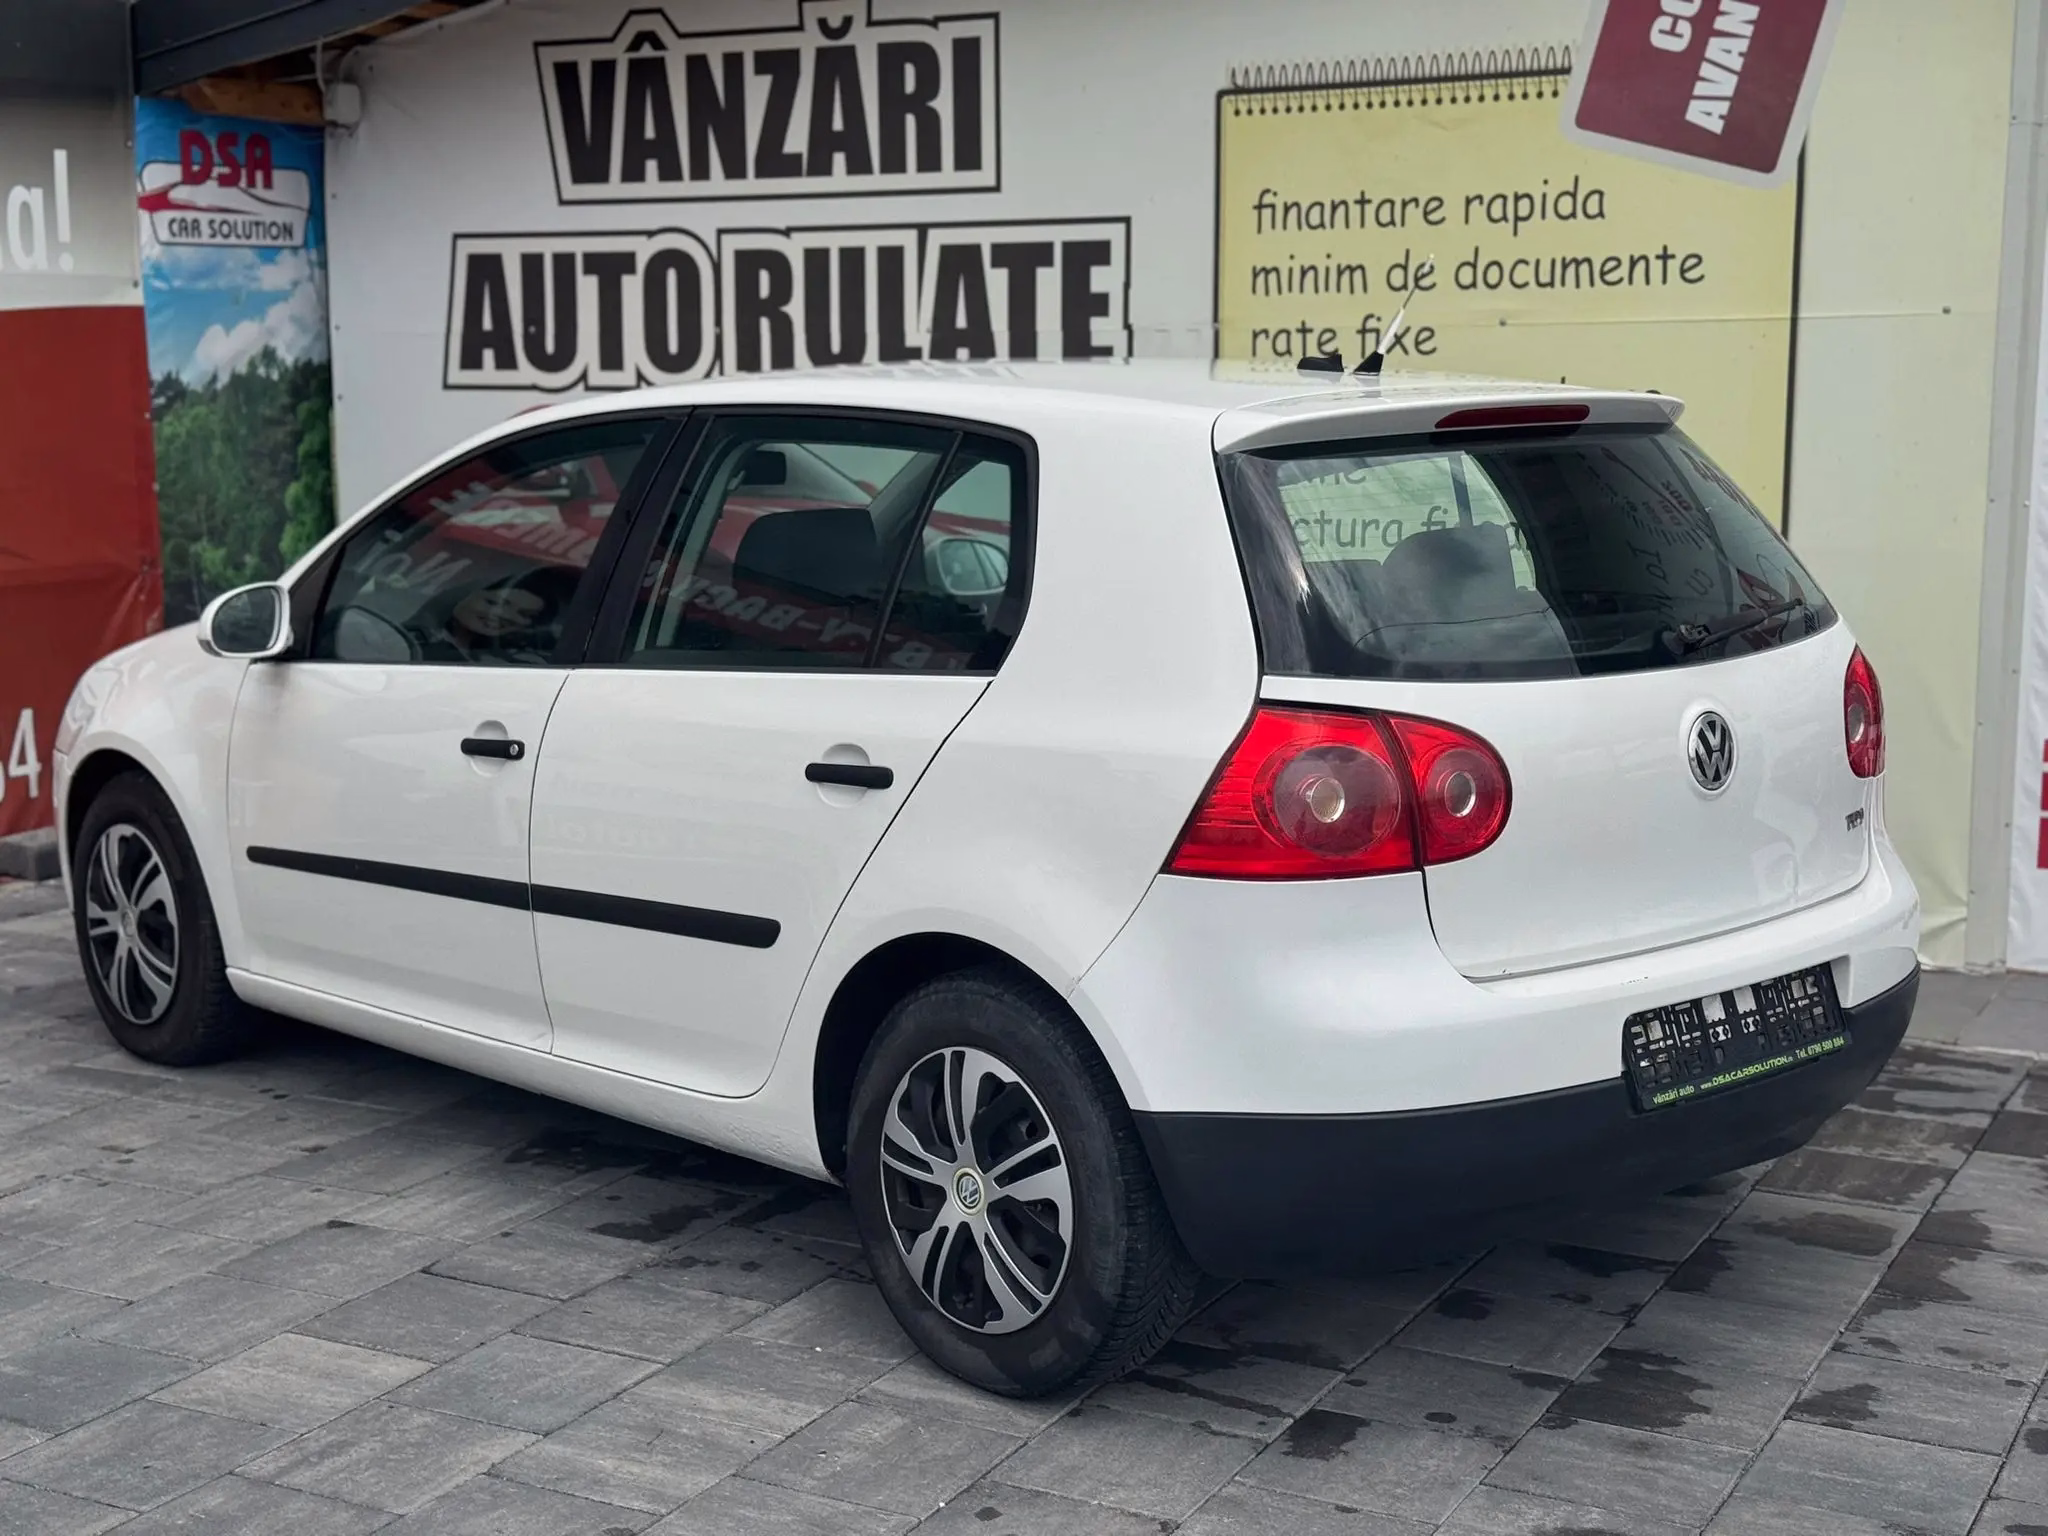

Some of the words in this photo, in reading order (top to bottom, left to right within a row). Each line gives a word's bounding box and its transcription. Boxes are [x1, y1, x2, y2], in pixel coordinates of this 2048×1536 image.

[553, 15, 982, 184] VÂNZĂRI
[180, 129, 273, 190] DSA
[0, 148, 74, 272] a!
[168, 218, 202, 239] CAR
[208, 219, 294, 241] SOLUTION
[1252, 187, 1446, 235] finantare
[1463, 175, 1606, 236] rapida
[1251, 252, 1368, 296] minim
[1386, 248, 1437, 292] de
[1454, 244, 1706, 292] documente
[459, 248, 705, 374] AUTO
[735, 240, 1113, 374] RULATE
[1251, 320, 1340, 358] rate
[1356, 313, 1438, 358] fixe
[1293, 509, 1404, 549] ctura
